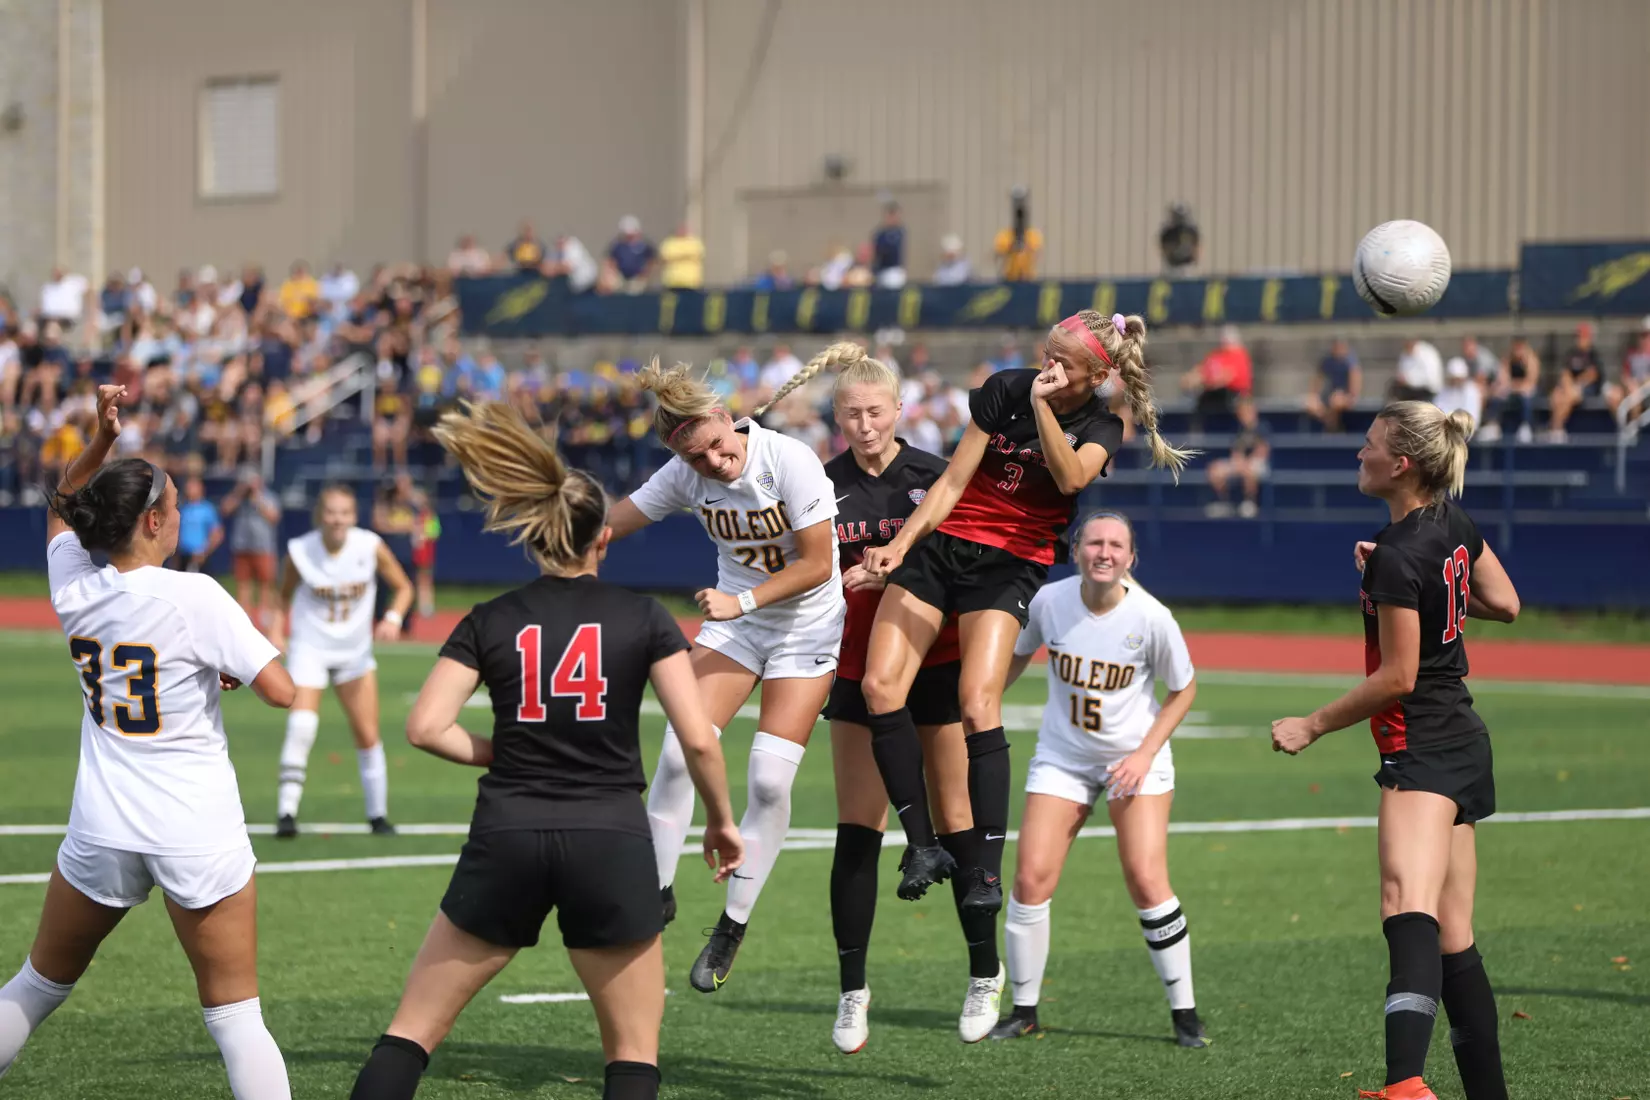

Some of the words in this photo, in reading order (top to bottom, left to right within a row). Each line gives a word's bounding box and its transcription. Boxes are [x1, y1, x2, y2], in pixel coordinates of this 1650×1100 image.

[997, 462, 1023, 494] 3
[837, 522, 872, 543] ALL
[733, 544, 785, 576] 20
[1442, 544, 1470, 644] 13
[69, 635, 162, 736] 33
[516, 623, 607, 722] 14
[1048, 649, 1135, 691] TOLEDO
[1071, 694, 1101, 731] 15
